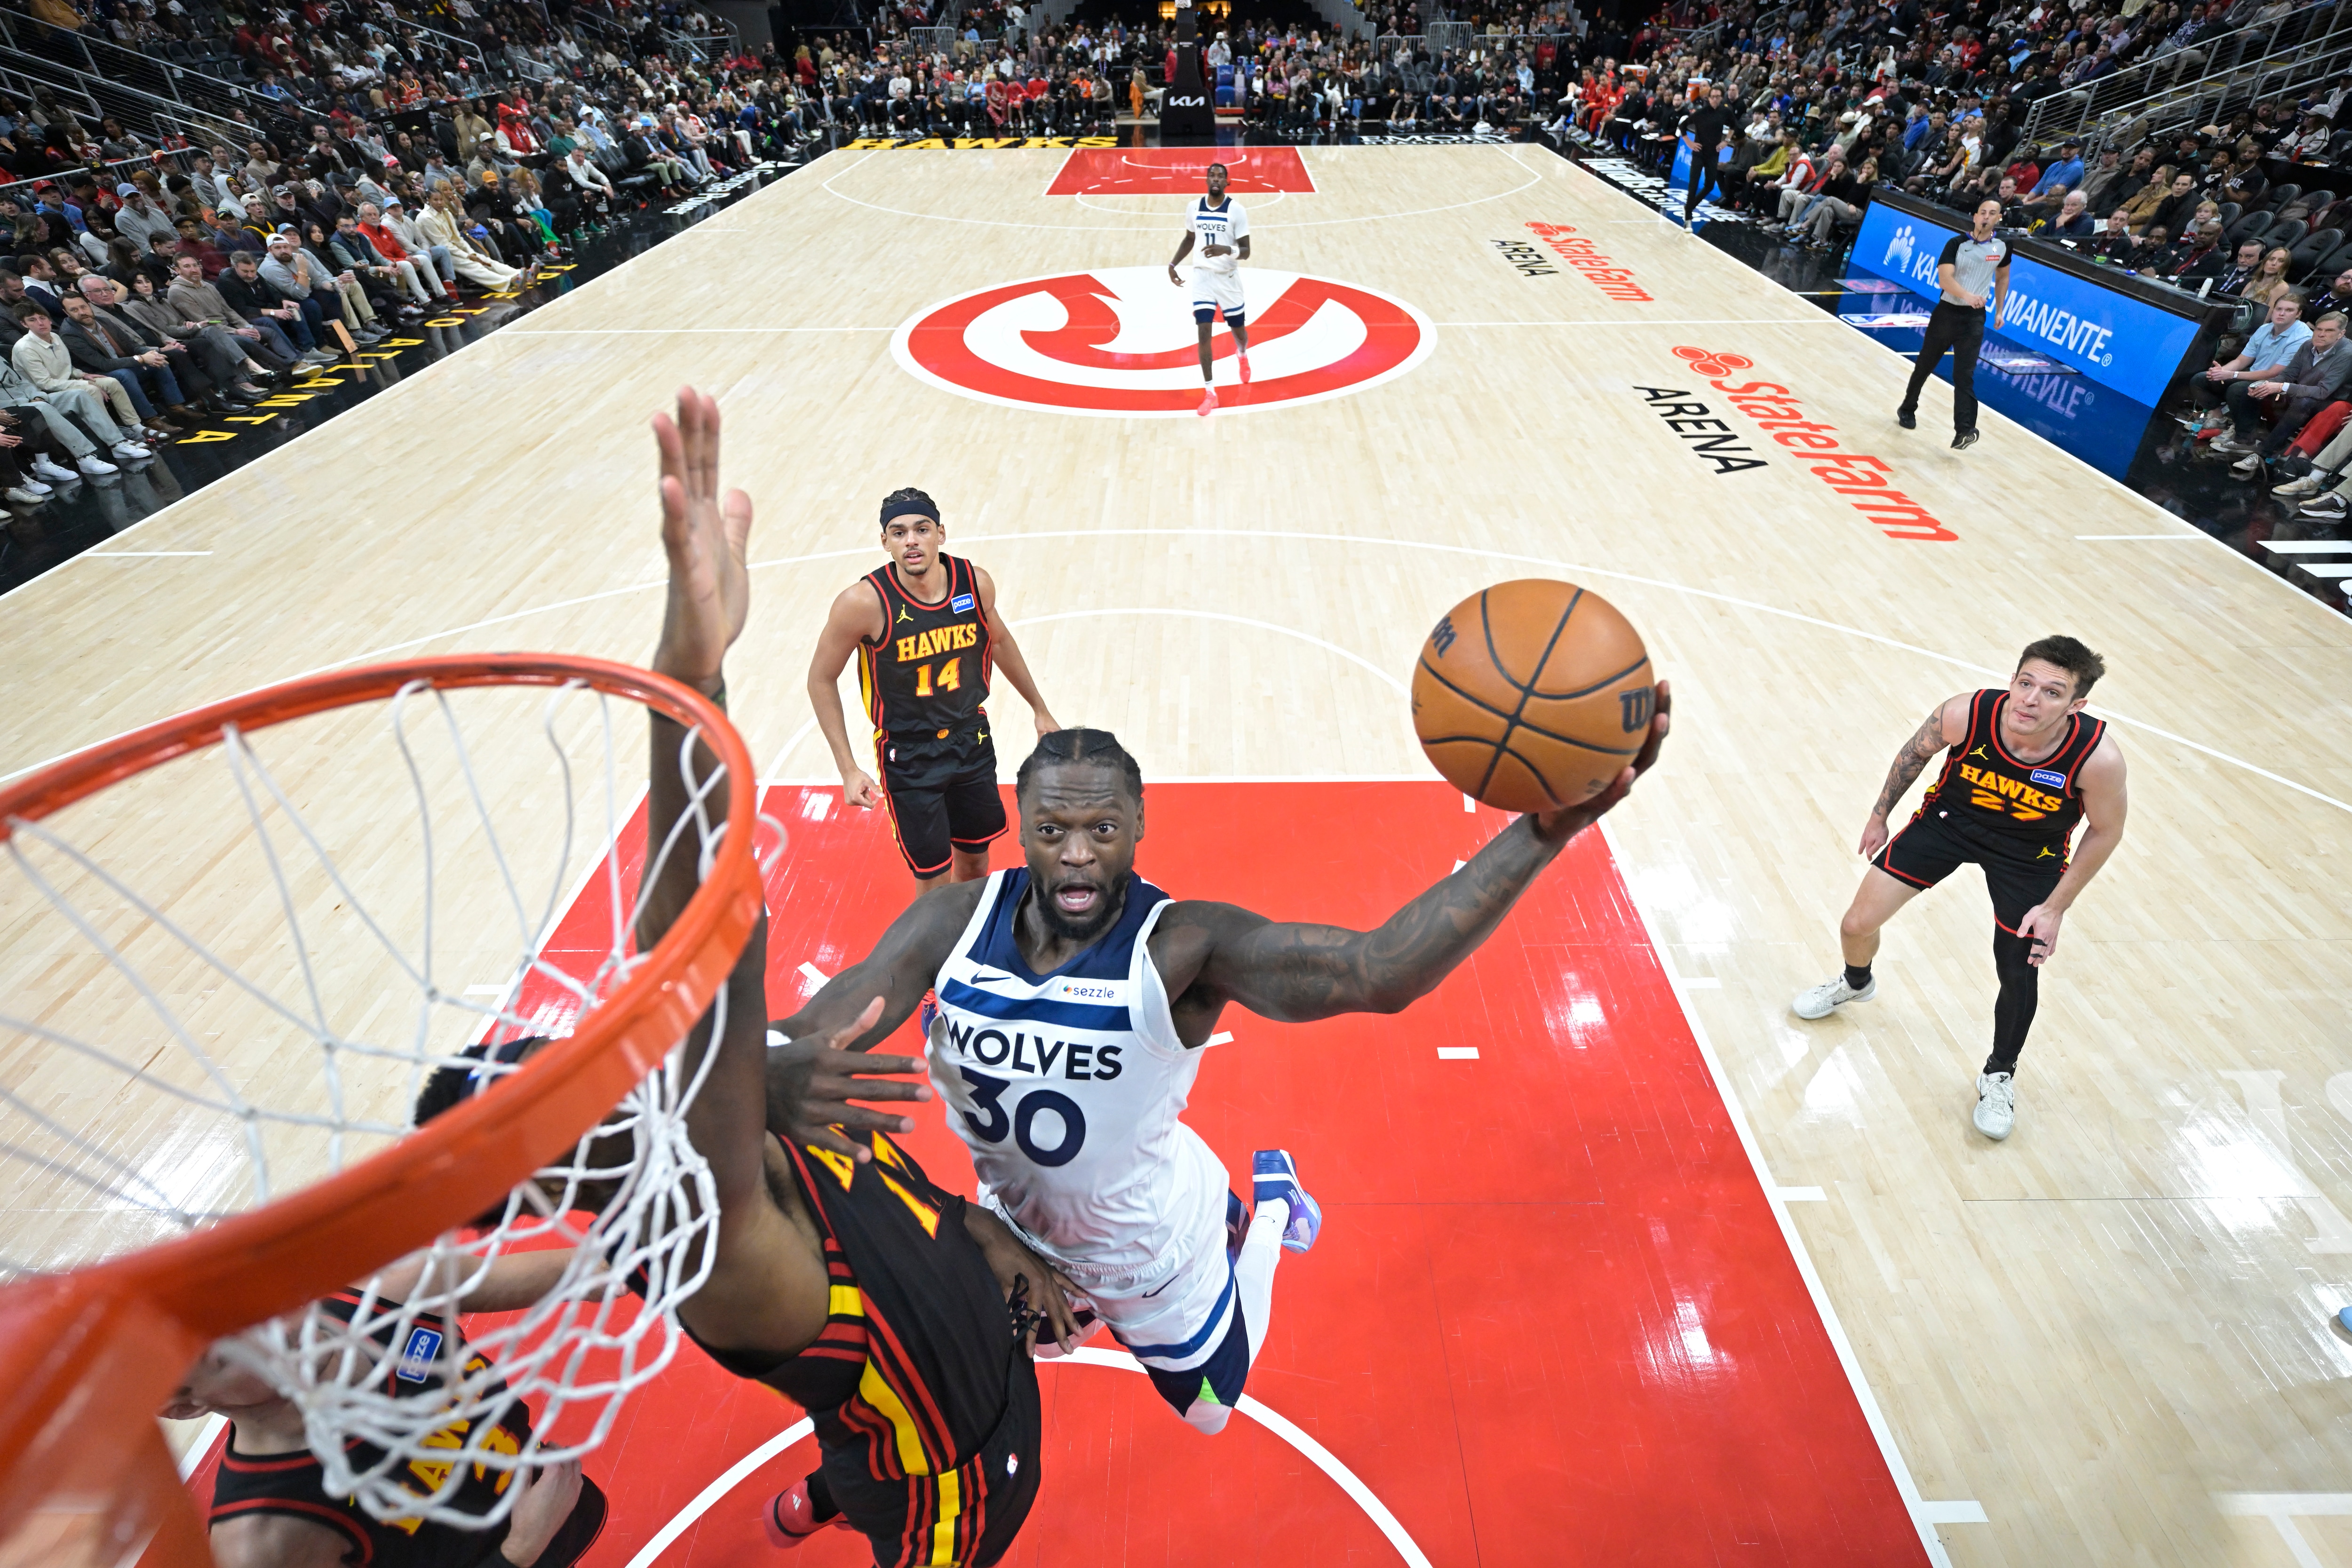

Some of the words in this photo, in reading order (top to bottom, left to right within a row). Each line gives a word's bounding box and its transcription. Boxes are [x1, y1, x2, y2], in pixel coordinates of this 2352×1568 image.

[1169, 96, 1205, 107] KIA
[838, 136, 1119, 150] HAWKS
[1196, 223, 1226, 232] WOLVES
[1205, 233, 1216, 245] 11
[1490, 239, 1559, 277] ARENA
[175, 338, 425, 445] ATLANTA
[1632, 385, 1769, 474] ARENA
[953, 598, 971, 610] paze
[896, 621, 978, 663] HAWKS
[915, 656, 961, 698] 14
[1959, 763, 2064, 812] HAWKS
[2034, 772, 2061, 783] paze
[1971, 788, 2047, 822] 27
[1073, 987, 1115, 999] sezzle
[942, 1011, 1123, 1081] WOLVES
[960, 1065, 1087, 1167] 30
